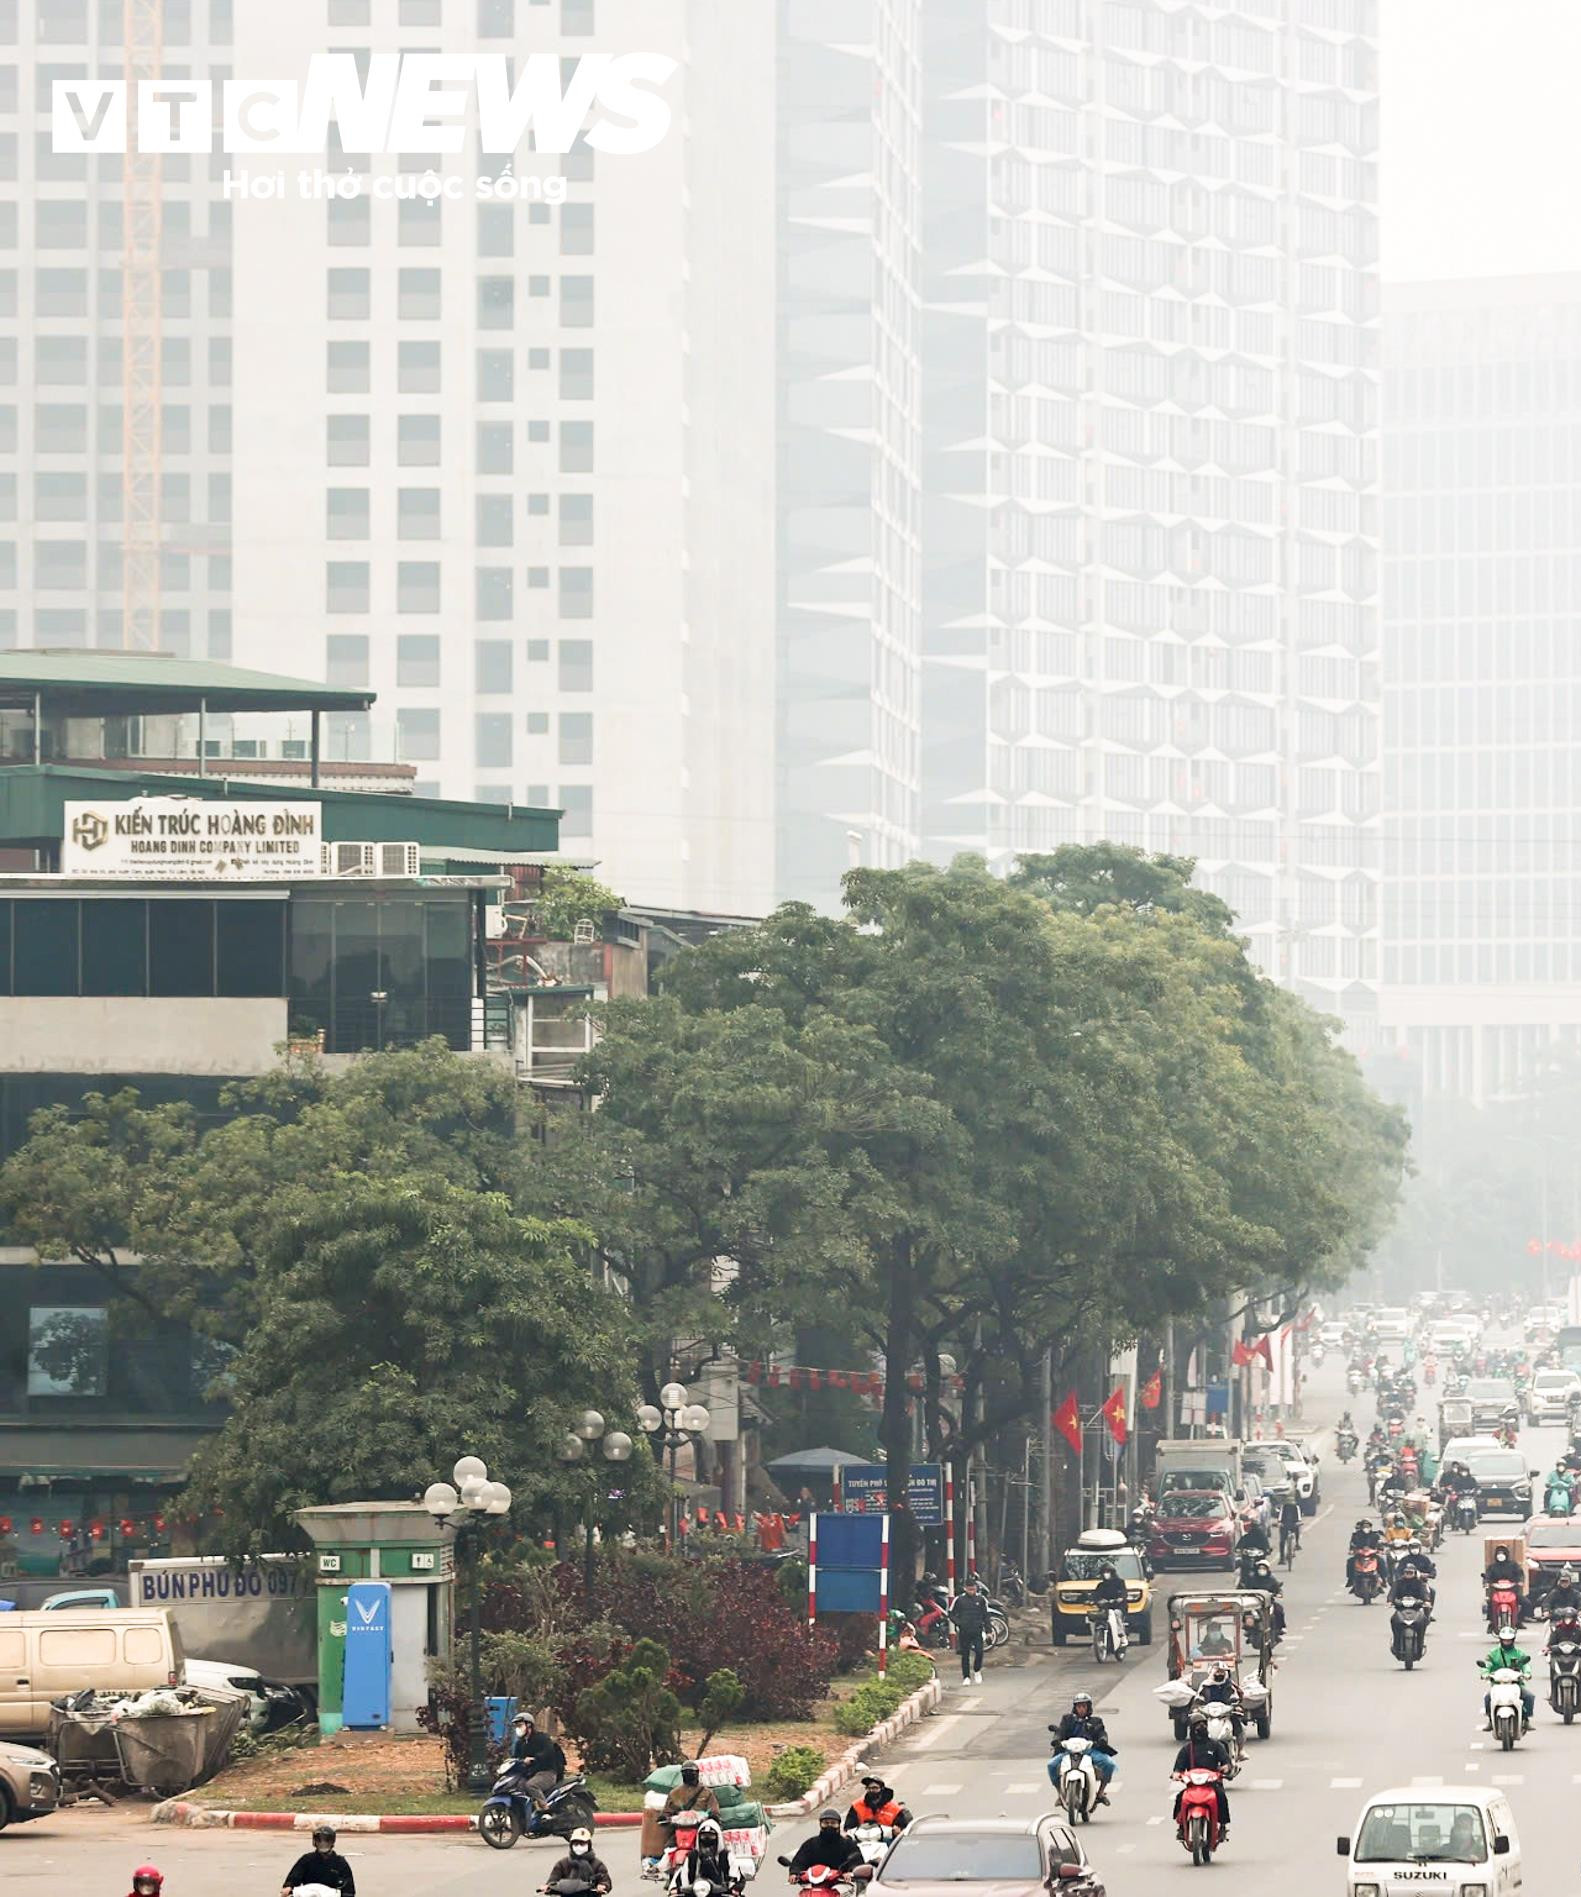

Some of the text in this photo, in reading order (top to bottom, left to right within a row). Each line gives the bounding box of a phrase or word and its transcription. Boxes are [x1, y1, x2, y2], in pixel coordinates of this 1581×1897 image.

[115, 807, 314, 835] KIẾN TRÚC HOÀNG ĐÌNH
[131, 841, 166, 854] HOANG
[171, 841, 196, 854] DINH
[256, 841, 299, 854] LIMITED
[323, 1558, 337, 1568] WC
[143, 1570, 185, 1600] BÚN
[1394, 1871, 1447, 1880] SUZUKI
